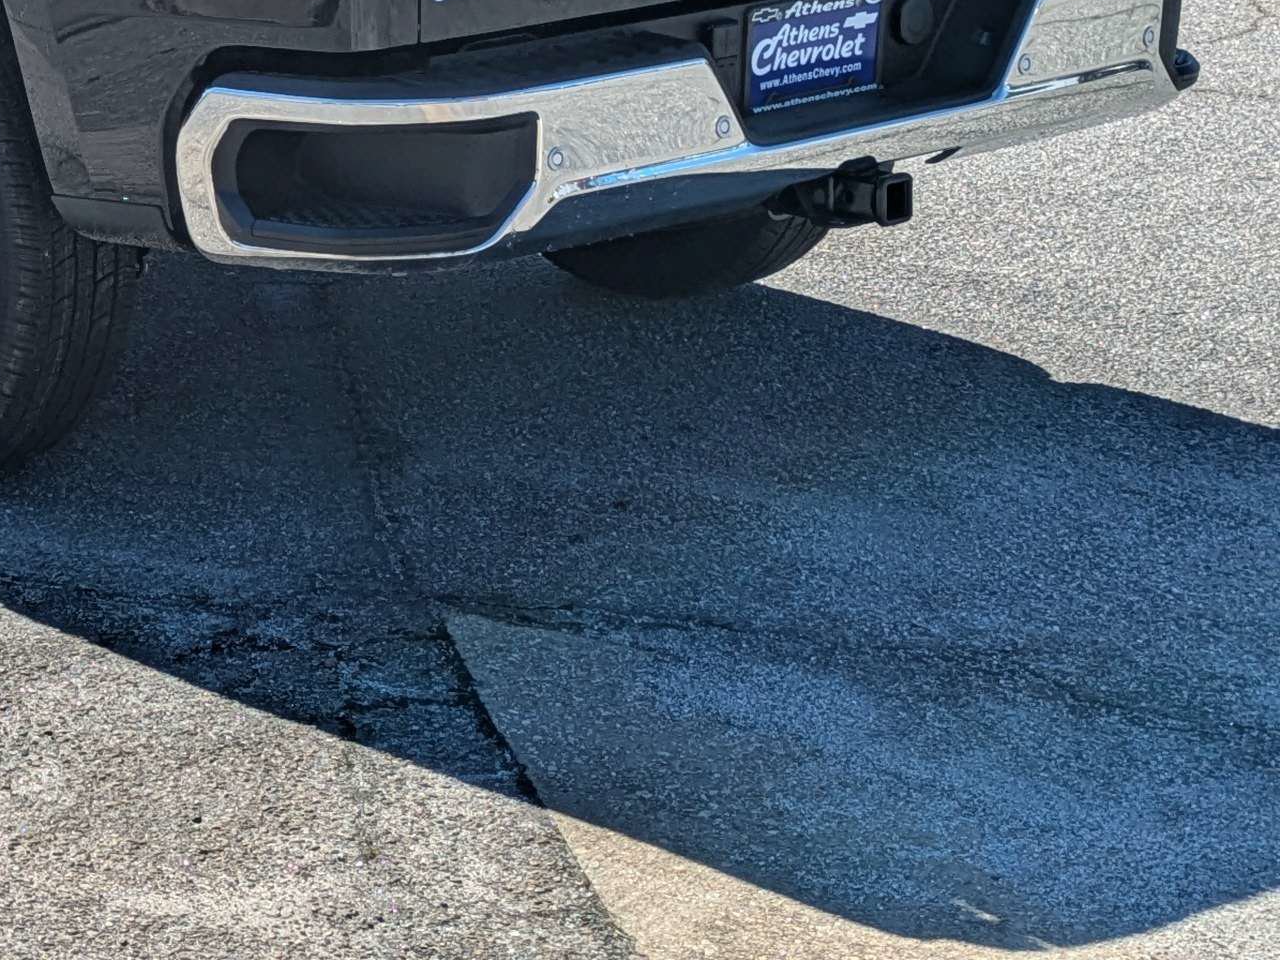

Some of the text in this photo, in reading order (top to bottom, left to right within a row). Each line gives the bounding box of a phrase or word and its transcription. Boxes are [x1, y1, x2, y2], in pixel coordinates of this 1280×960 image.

[773, 23, 840, 48] Athens
[751, 33, 866, 76] Chevrolet
[759, 62, 862, 91] www.AthensChevy.com
[752, 83, 878, 114] www.athenschevy.com
